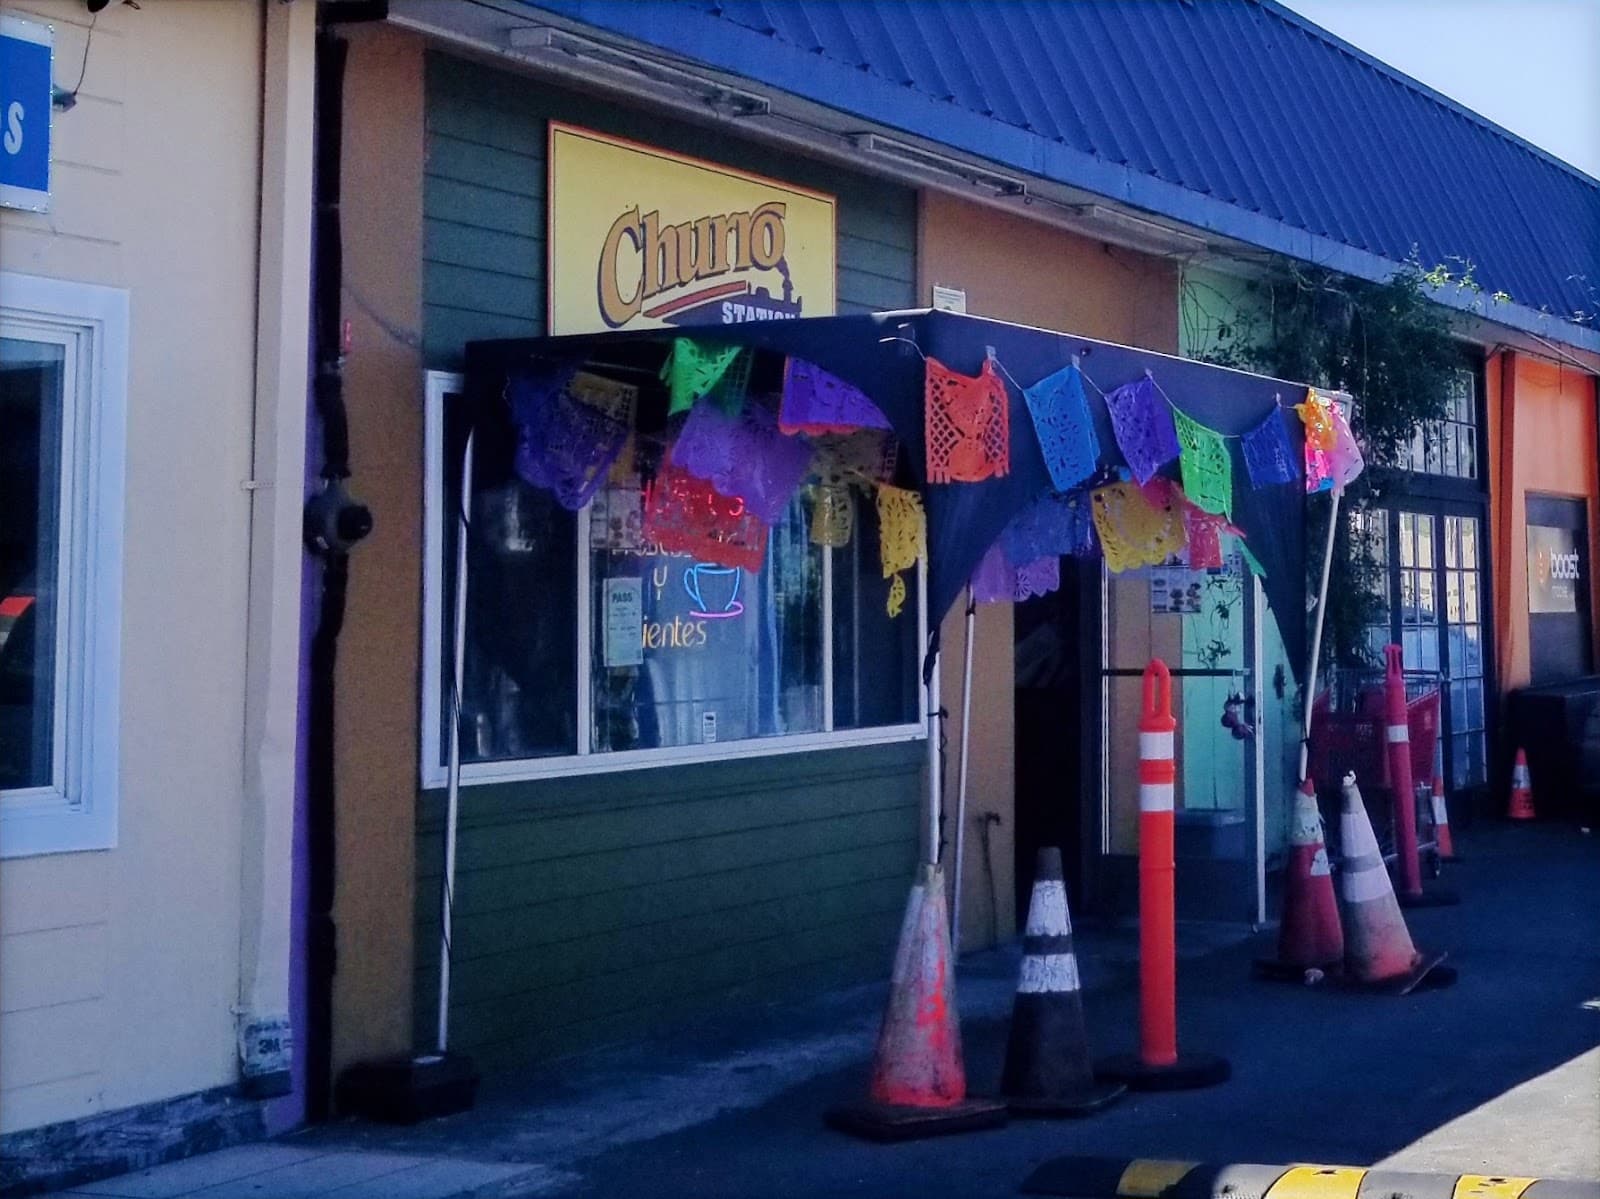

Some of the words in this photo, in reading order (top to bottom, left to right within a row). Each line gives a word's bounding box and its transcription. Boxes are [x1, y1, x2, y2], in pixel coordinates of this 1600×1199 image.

[597, 202, 787, 328] Churro
[722, 302, 796, 325] STATI
[1550, 547, 1580, 579] boost
